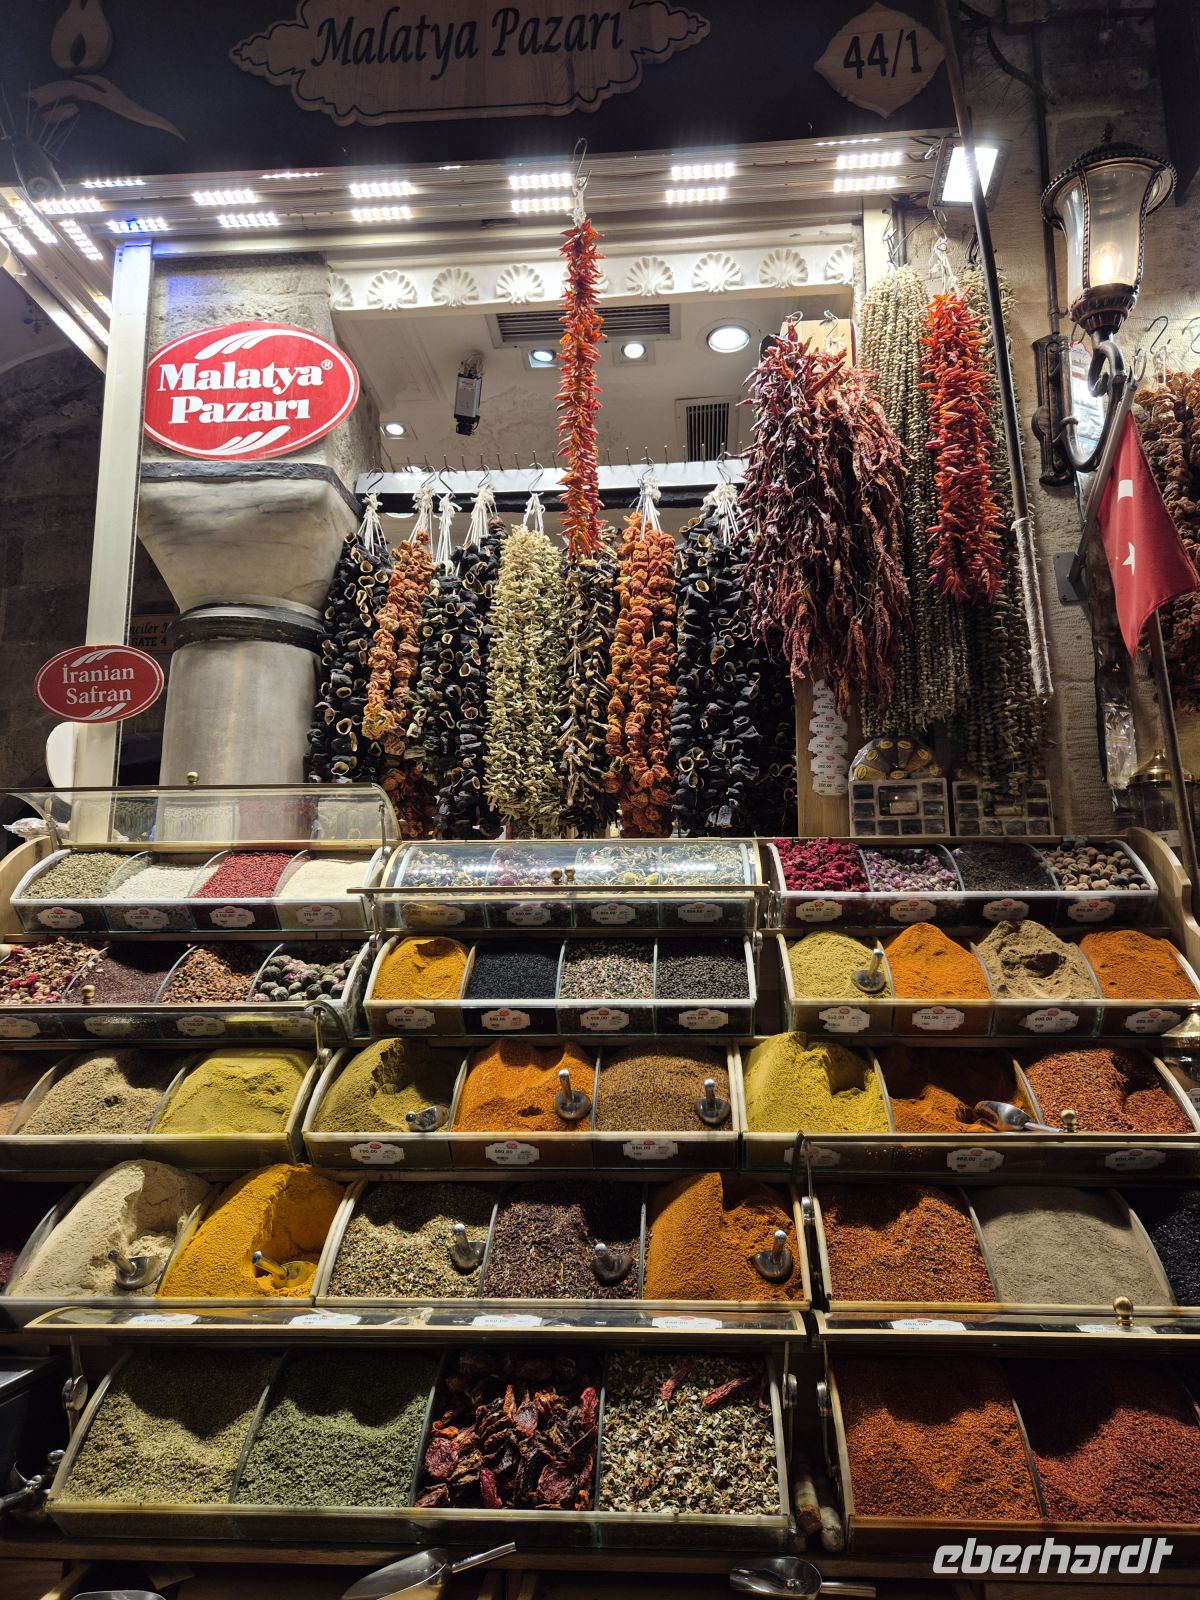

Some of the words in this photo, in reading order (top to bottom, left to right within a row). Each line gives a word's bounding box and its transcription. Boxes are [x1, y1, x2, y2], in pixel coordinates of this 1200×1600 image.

[310, 6, 478, 80] Malatya
[491, 7, 624, 57] Pazarı
[843, 29, 922, 80] 44/1
[168, 395, 311, 424] Pazarı
[131, 636, 157, 647] GATE
[160, 636, 167, 647] 4
[66, 685, 132, 705] Safran
